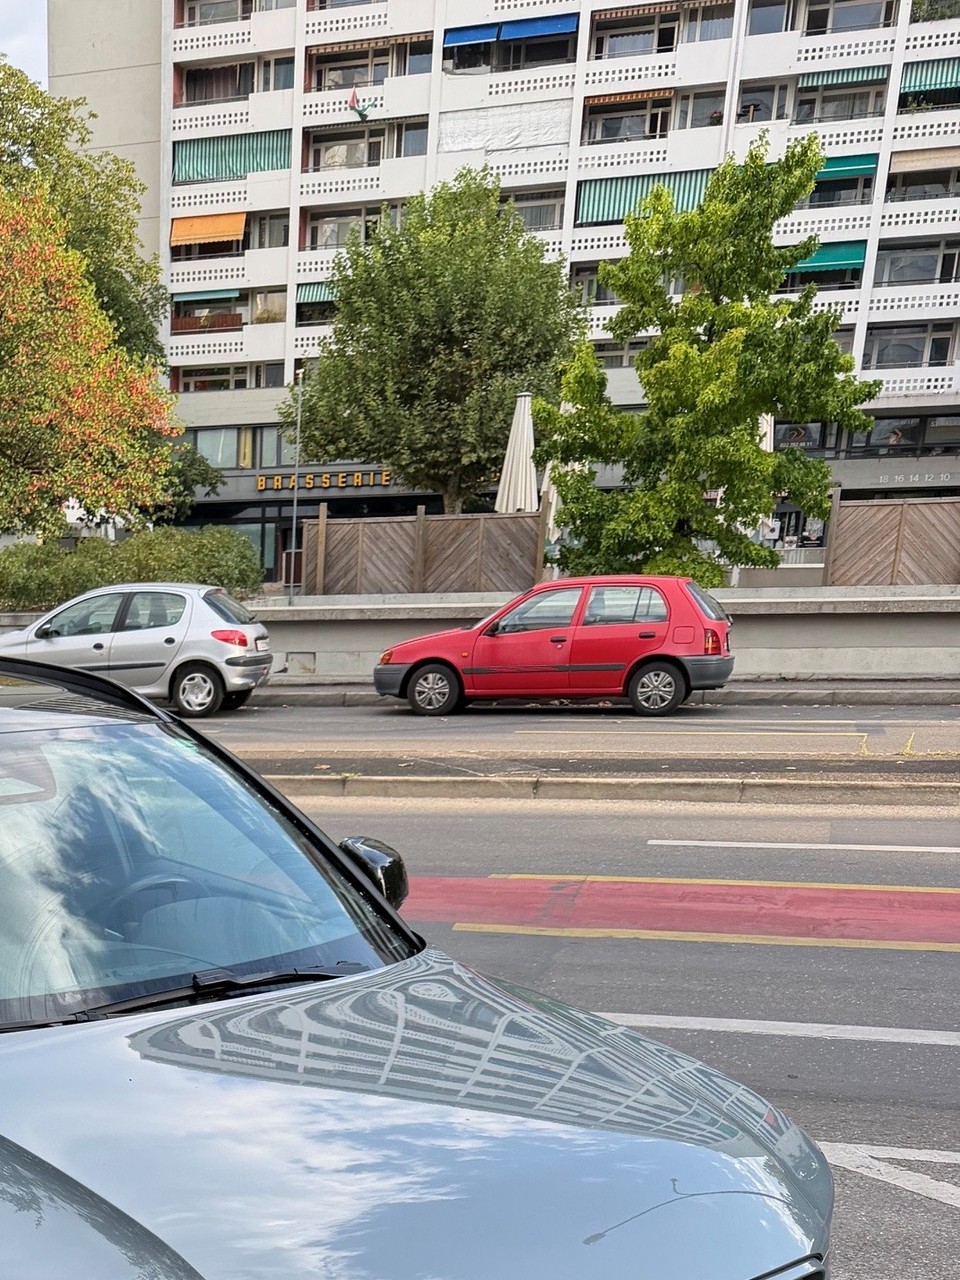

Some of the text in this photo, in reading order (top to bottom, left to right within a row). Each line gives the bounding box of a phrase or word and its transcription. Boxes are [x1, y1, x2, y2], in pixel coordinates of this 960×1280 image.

[257, 471, 392, 491] BRASSERIE
[879, 473, 951, 483] 18 16 14 12 10
